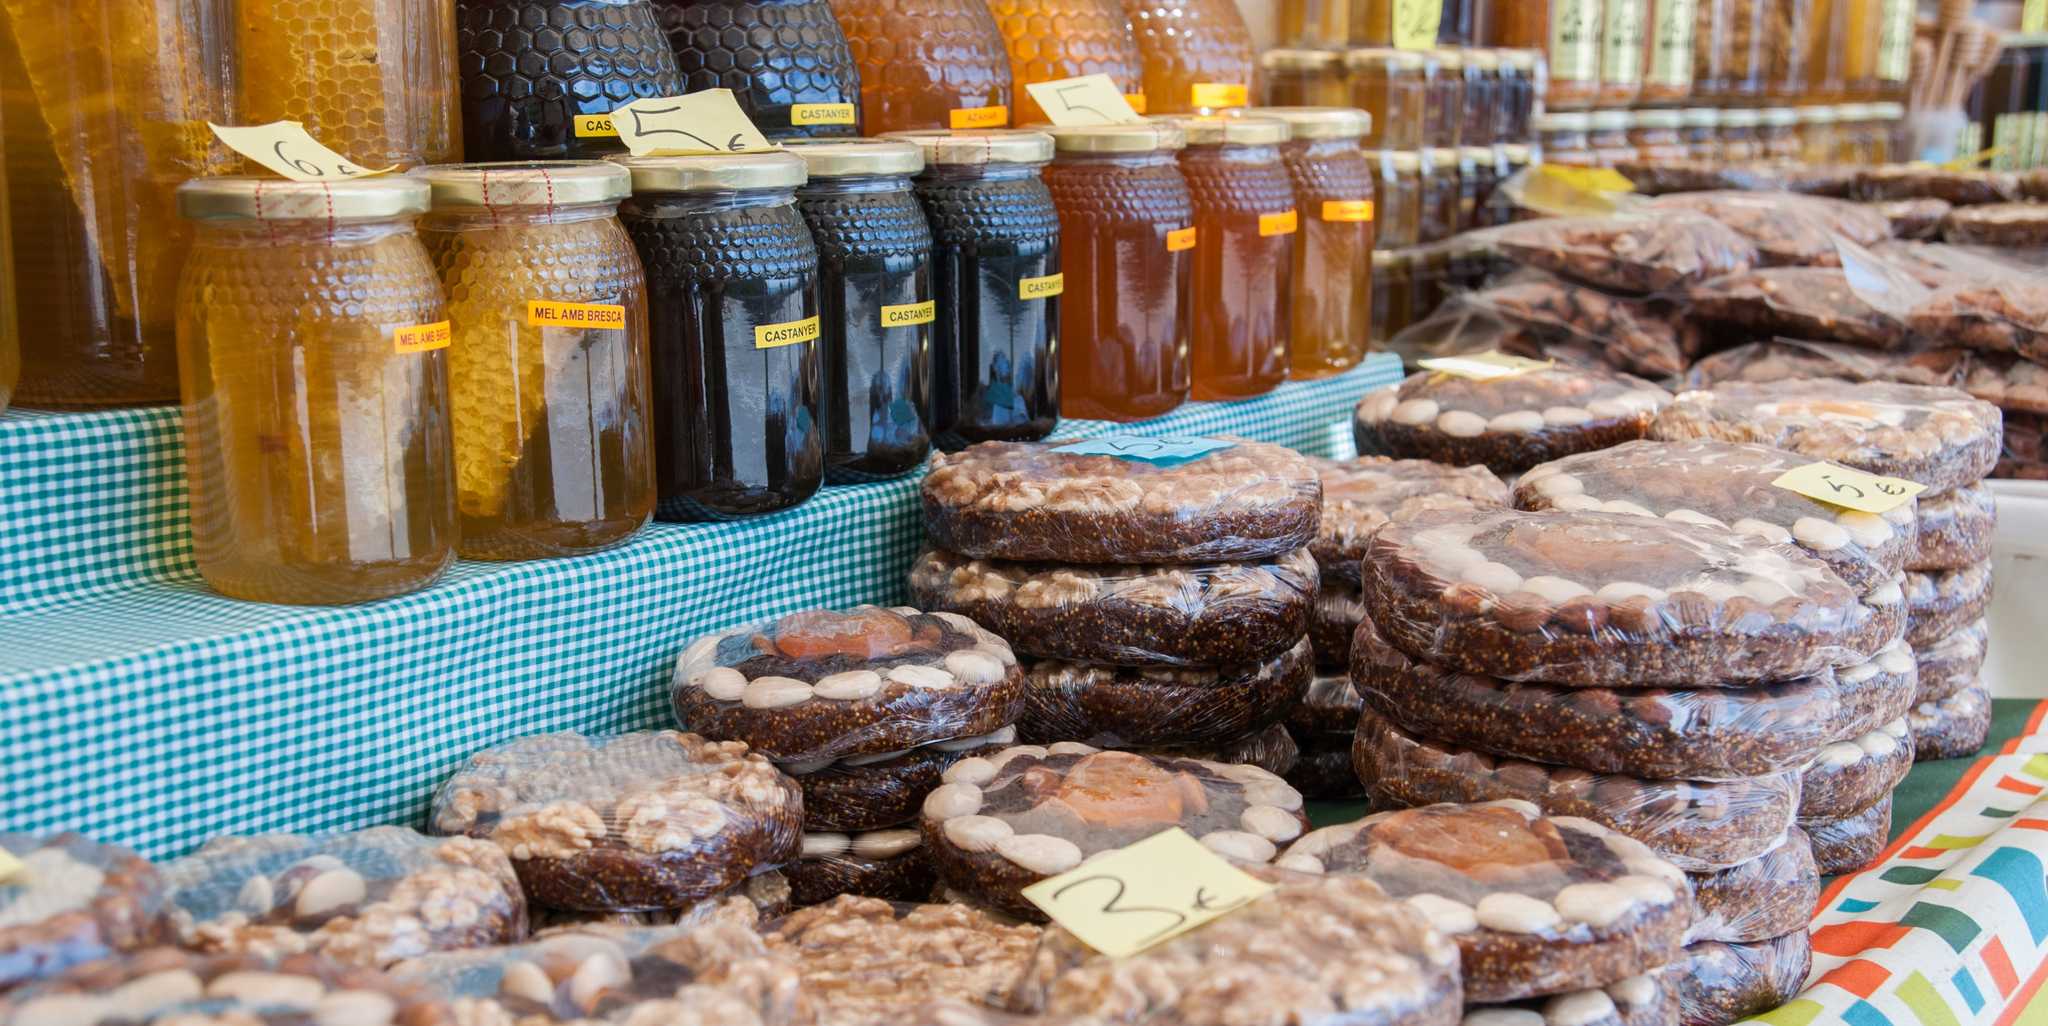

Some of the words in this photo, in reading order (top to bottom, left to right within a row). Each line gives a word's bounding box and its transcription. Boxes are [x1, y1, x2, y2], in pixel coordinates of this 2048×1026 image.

[800, 109, 851, 120] CASTANYER
[630, 106, 720, 151] 5
[273, 140, 325, 177] 6
[534, 306, 558, 320] MEL
[561, 307, 584, 321] AMB
[587, 310, 622, 323] BRESCA
[889, 306, 933, 322] CASTANYER
[399, 333, 419, 346] MEL
[765, 322, 817, 343] CASTANYER
[1107, 433, 1163, 451] 5
[1821, 475, 1865, 498] 5
[1874, 481, 1906, 495] €
